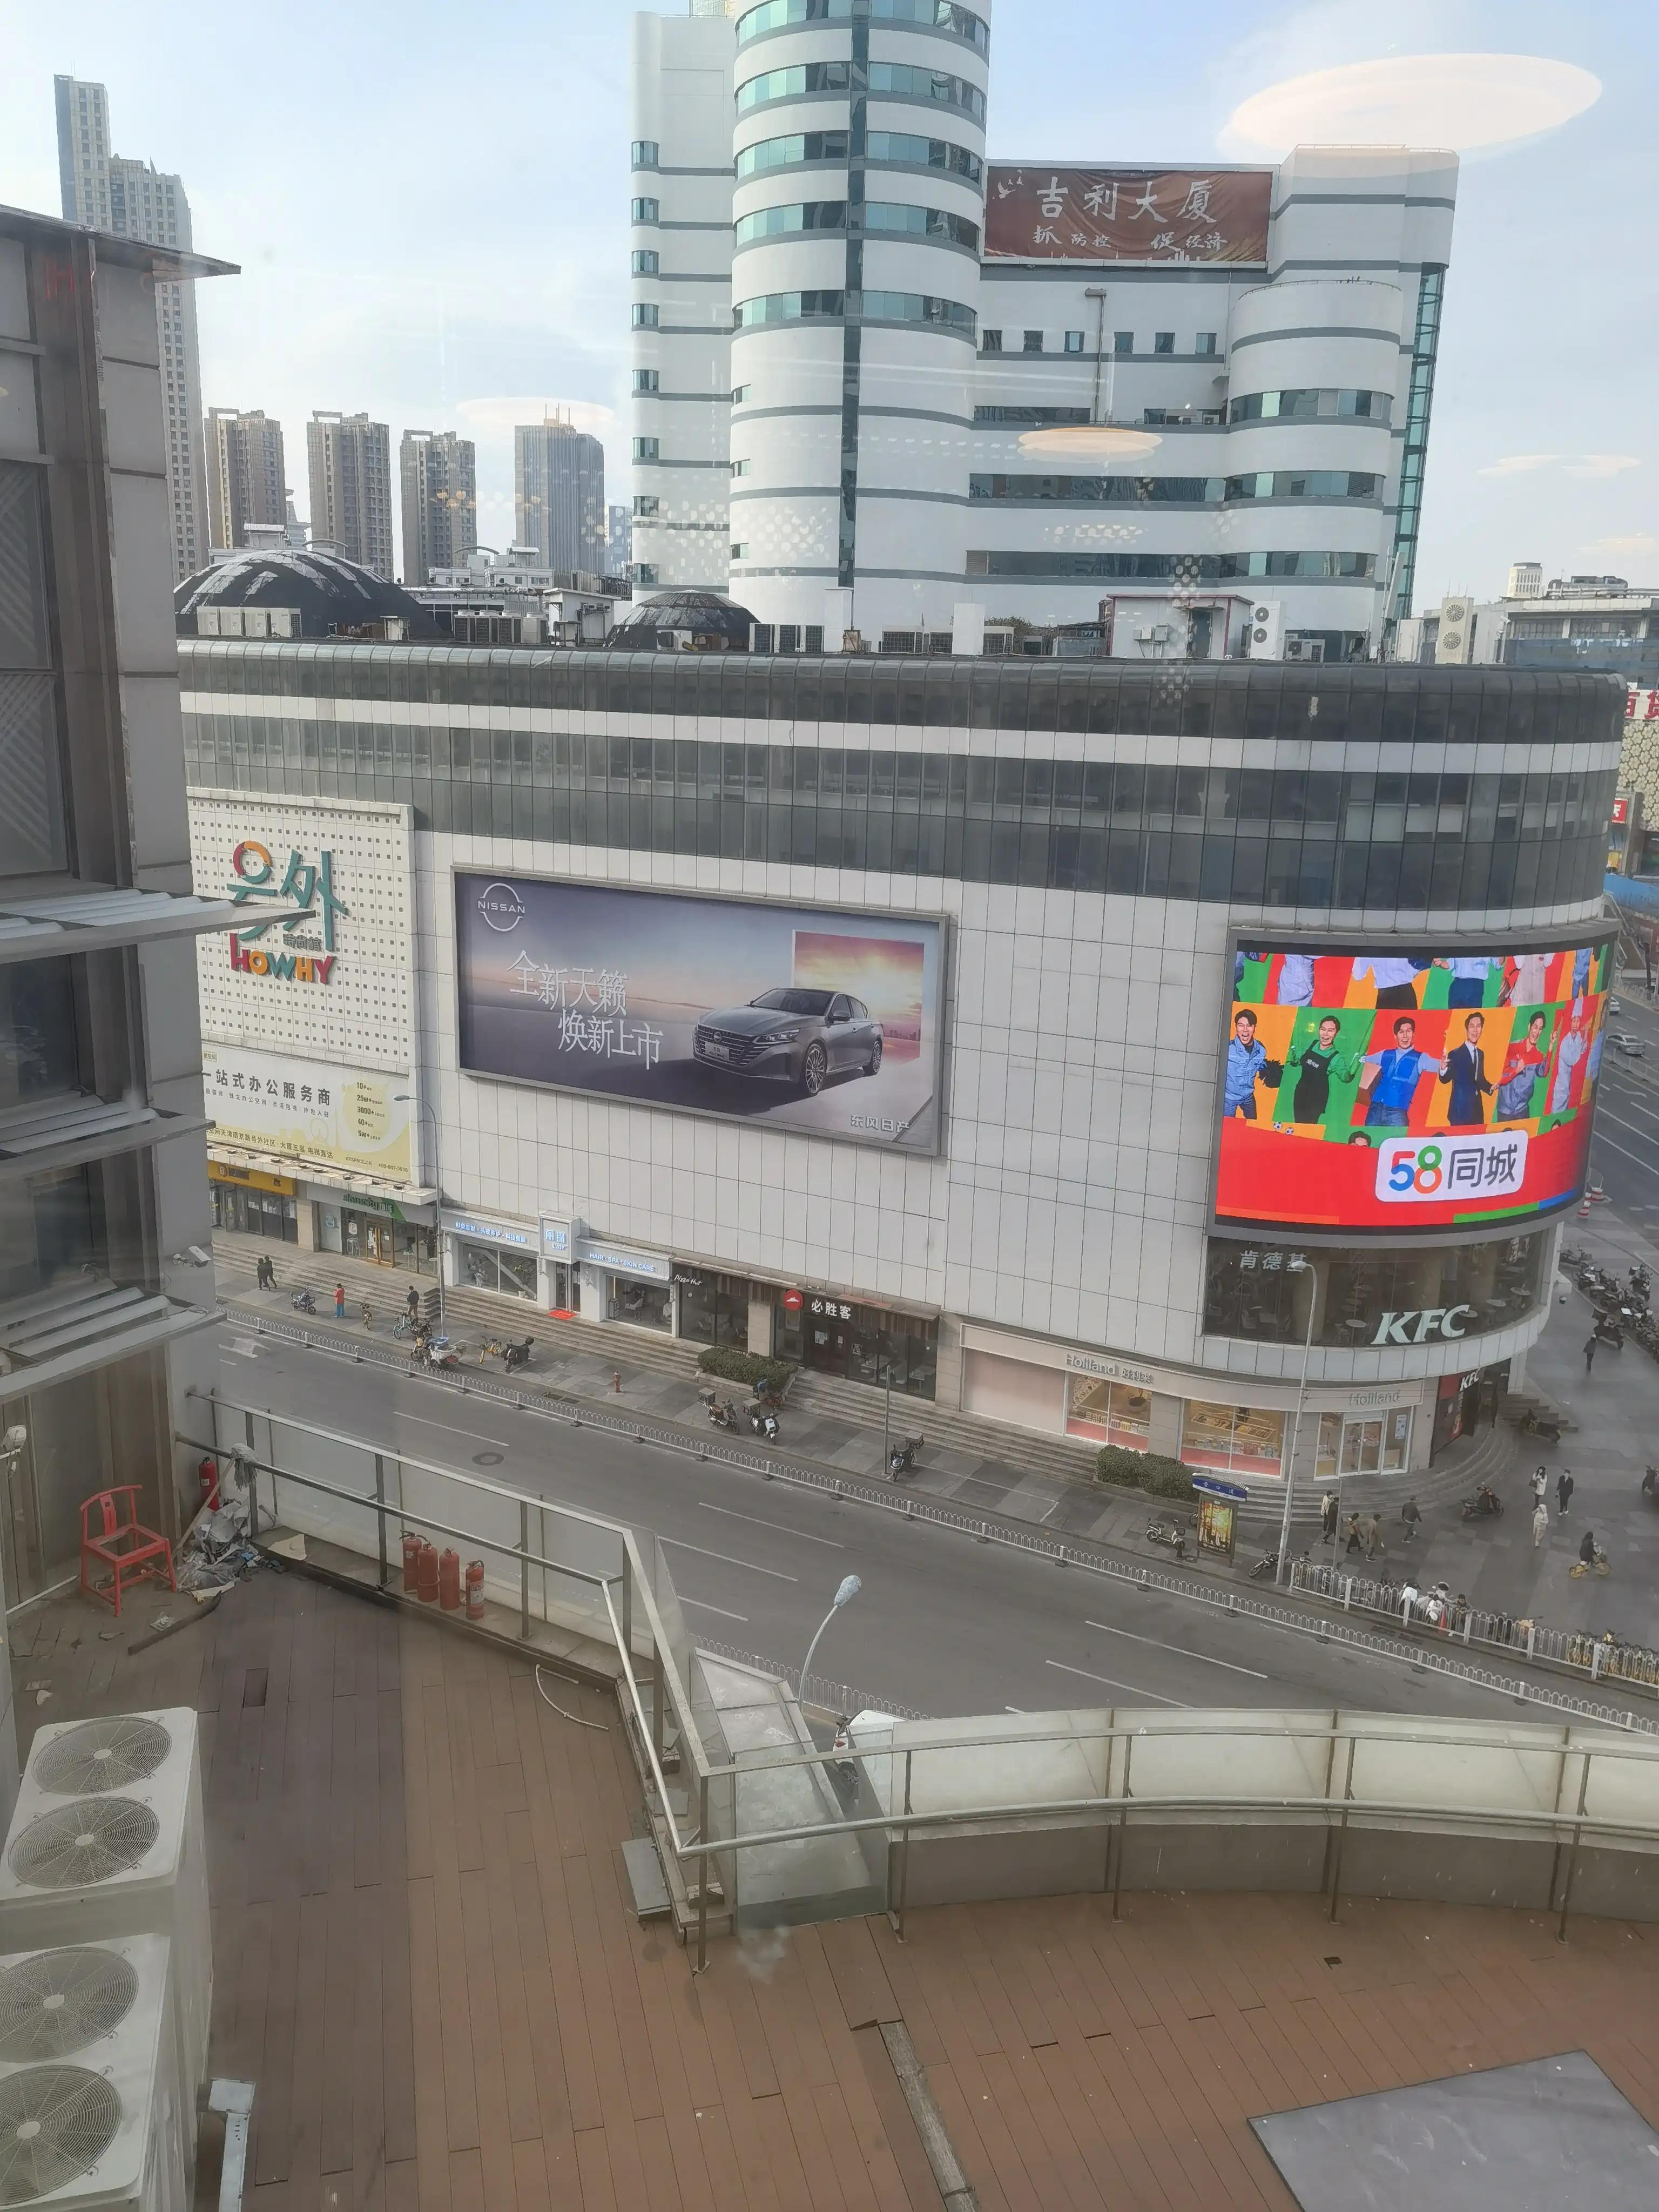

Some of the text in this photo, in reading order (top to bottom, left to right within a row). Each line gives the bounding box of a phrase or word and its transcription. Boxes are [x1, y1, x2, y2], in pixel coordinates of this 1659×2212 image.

[1036, 176, 1217, 223] 吉利大厦
[478, 901, 525, 914] NISSAN
[230, 933, 335, 984] HOWHY
[507, 950, 629, 1016] 全新天籁
[558, 1008, 664, 1070] 焕新上市
[201, 1069, 330, 1105] 一站式办公服务商
[851, 1114, 909, 1132] 东风日产
[206, 1127, 276, 1147] 空间天津南京路号外社区
[1389, 1144, 1518, 1194] 58同城
[608, 1256, 619, 1264] SPA
[638, 1263, 655, 1271] CARE
[1240, 1250, 1306, 1272] 肯德基
[675, 1274, 703, 1286] Pizza Hut
[811, 1299, 851, 1320] 必胜客
[1370, 1305, 1470, 1344] KFC
[1066, 1354, 1151, 1384] Holiland 好利来
[1460, 1368, 1481, 1392] KFC
[1349, 1390, 1400, 1405] Holiland
